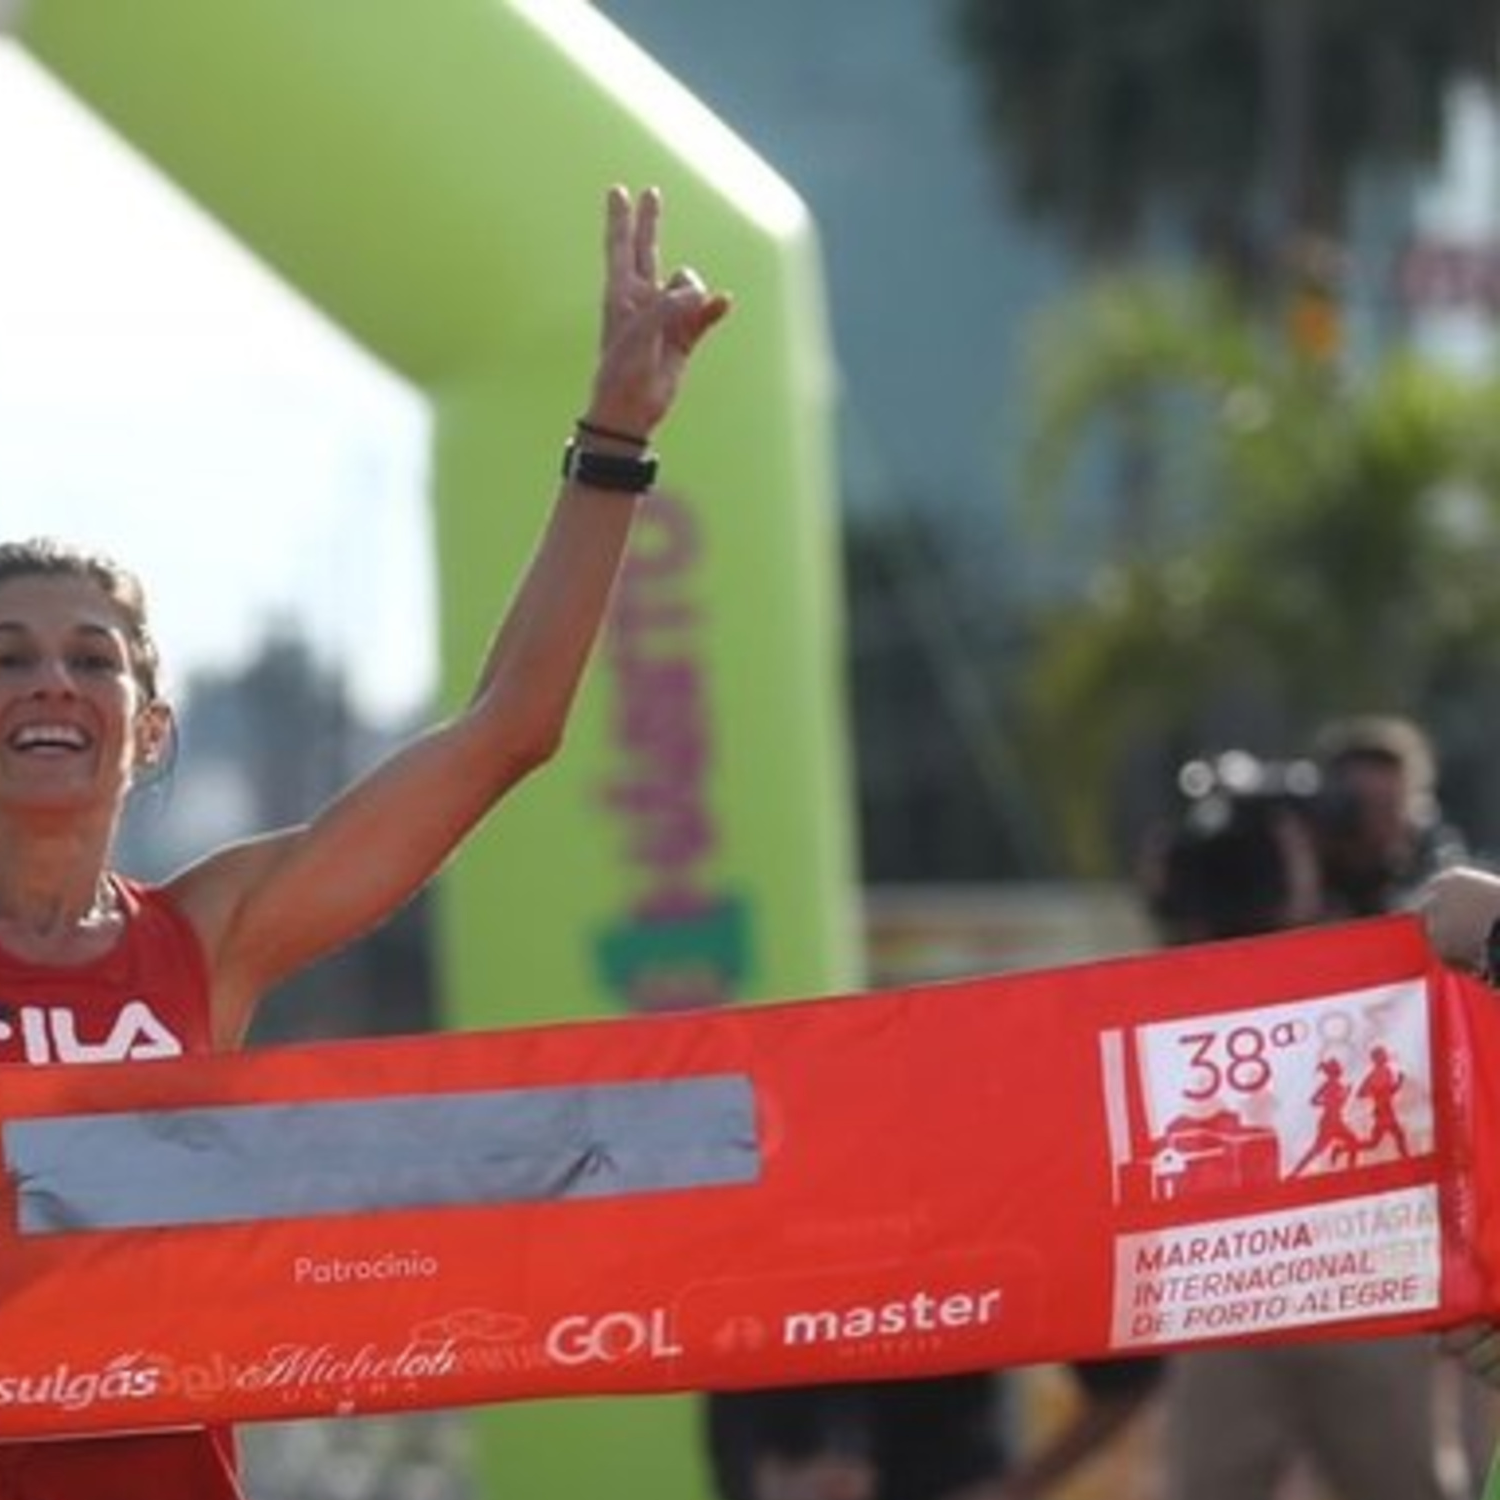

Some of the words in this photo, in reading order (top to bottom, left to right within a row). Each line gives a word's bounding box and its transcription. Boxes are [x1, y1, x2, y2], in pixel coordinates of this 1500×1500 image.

[1135, 1222, 1314, 1275] MARATONA
[1130, 1311, 1170, 1339] DE
[1182, 1296, 1287, 1330] PORTO
[1298, 1276, 1419, 1316] ALEGRE
[1132, 1252, 1376, 1307] INTERNACIONAL
[545, 1308, 683, 1365] GOL
[782, 1288, 1002, 1345] master
